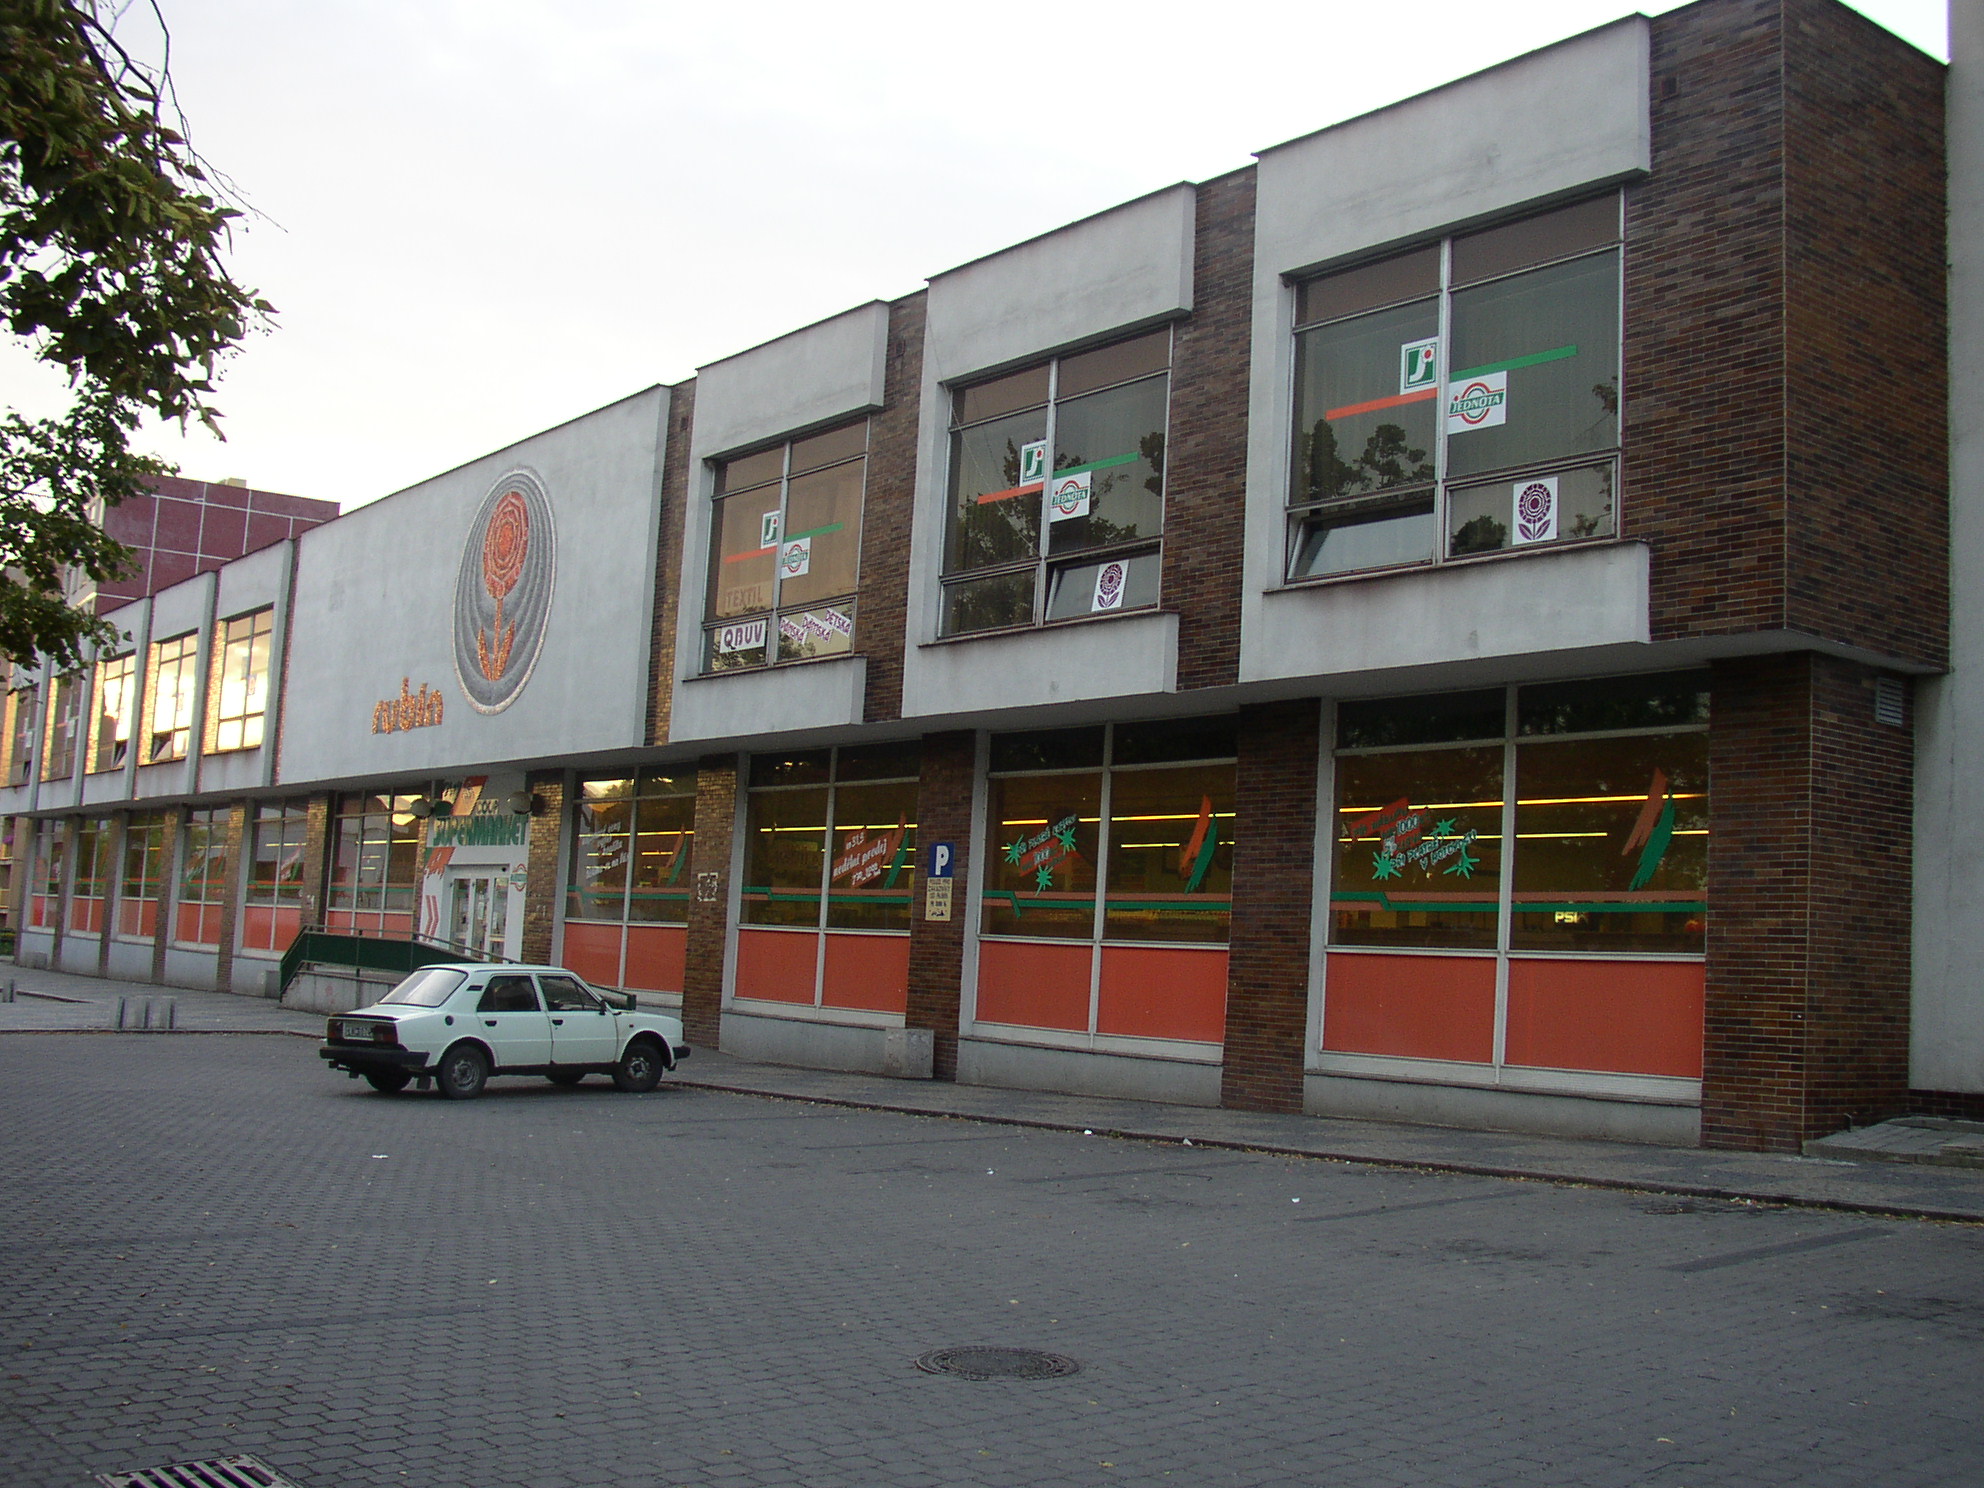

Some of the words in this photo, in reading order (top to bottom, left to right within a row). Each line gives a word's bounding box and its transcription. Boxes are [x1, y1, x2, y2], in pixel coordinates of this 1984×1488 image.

[727, 585, 761, 606] TEXTIL
[432, 814, 530, 847] SUPERMARKET
[935, 845, 949, 876] P
